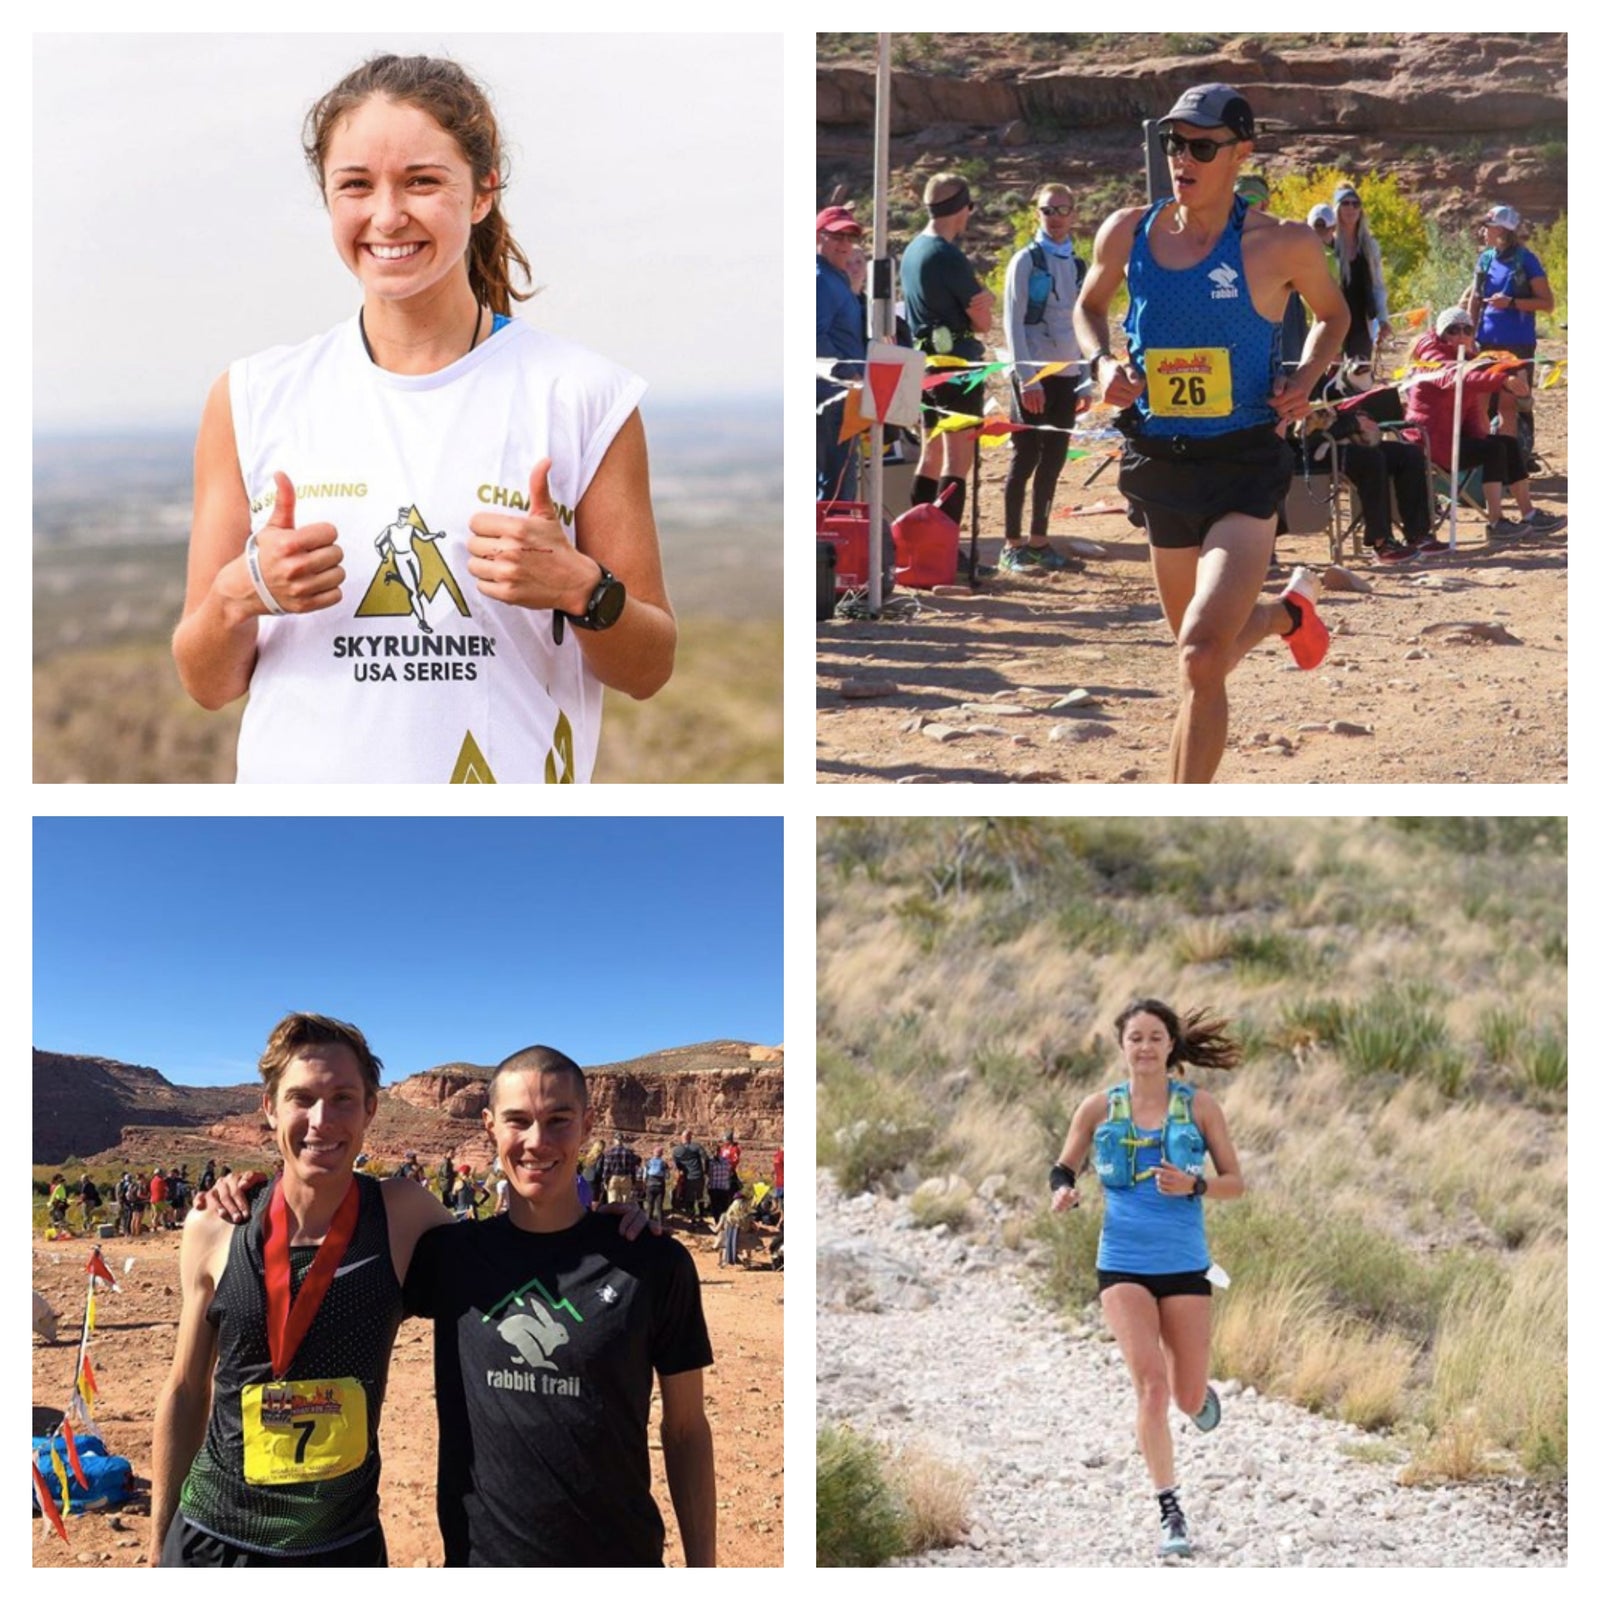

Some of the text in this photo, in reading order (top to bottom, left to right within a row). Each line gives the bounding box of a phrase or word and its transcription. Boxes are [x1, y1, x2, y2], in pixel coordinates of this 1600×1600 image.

[1211, 287, 1239, 299] rabbit
[1169, 376, 1206, 406] 26
[477, 484, 574, 526] CHAN
[354, 661, 478, 682] USA SERIES
[486, 1368, 580, 1397] rabbit trail
[293, 1420, 316, 1464] 7
